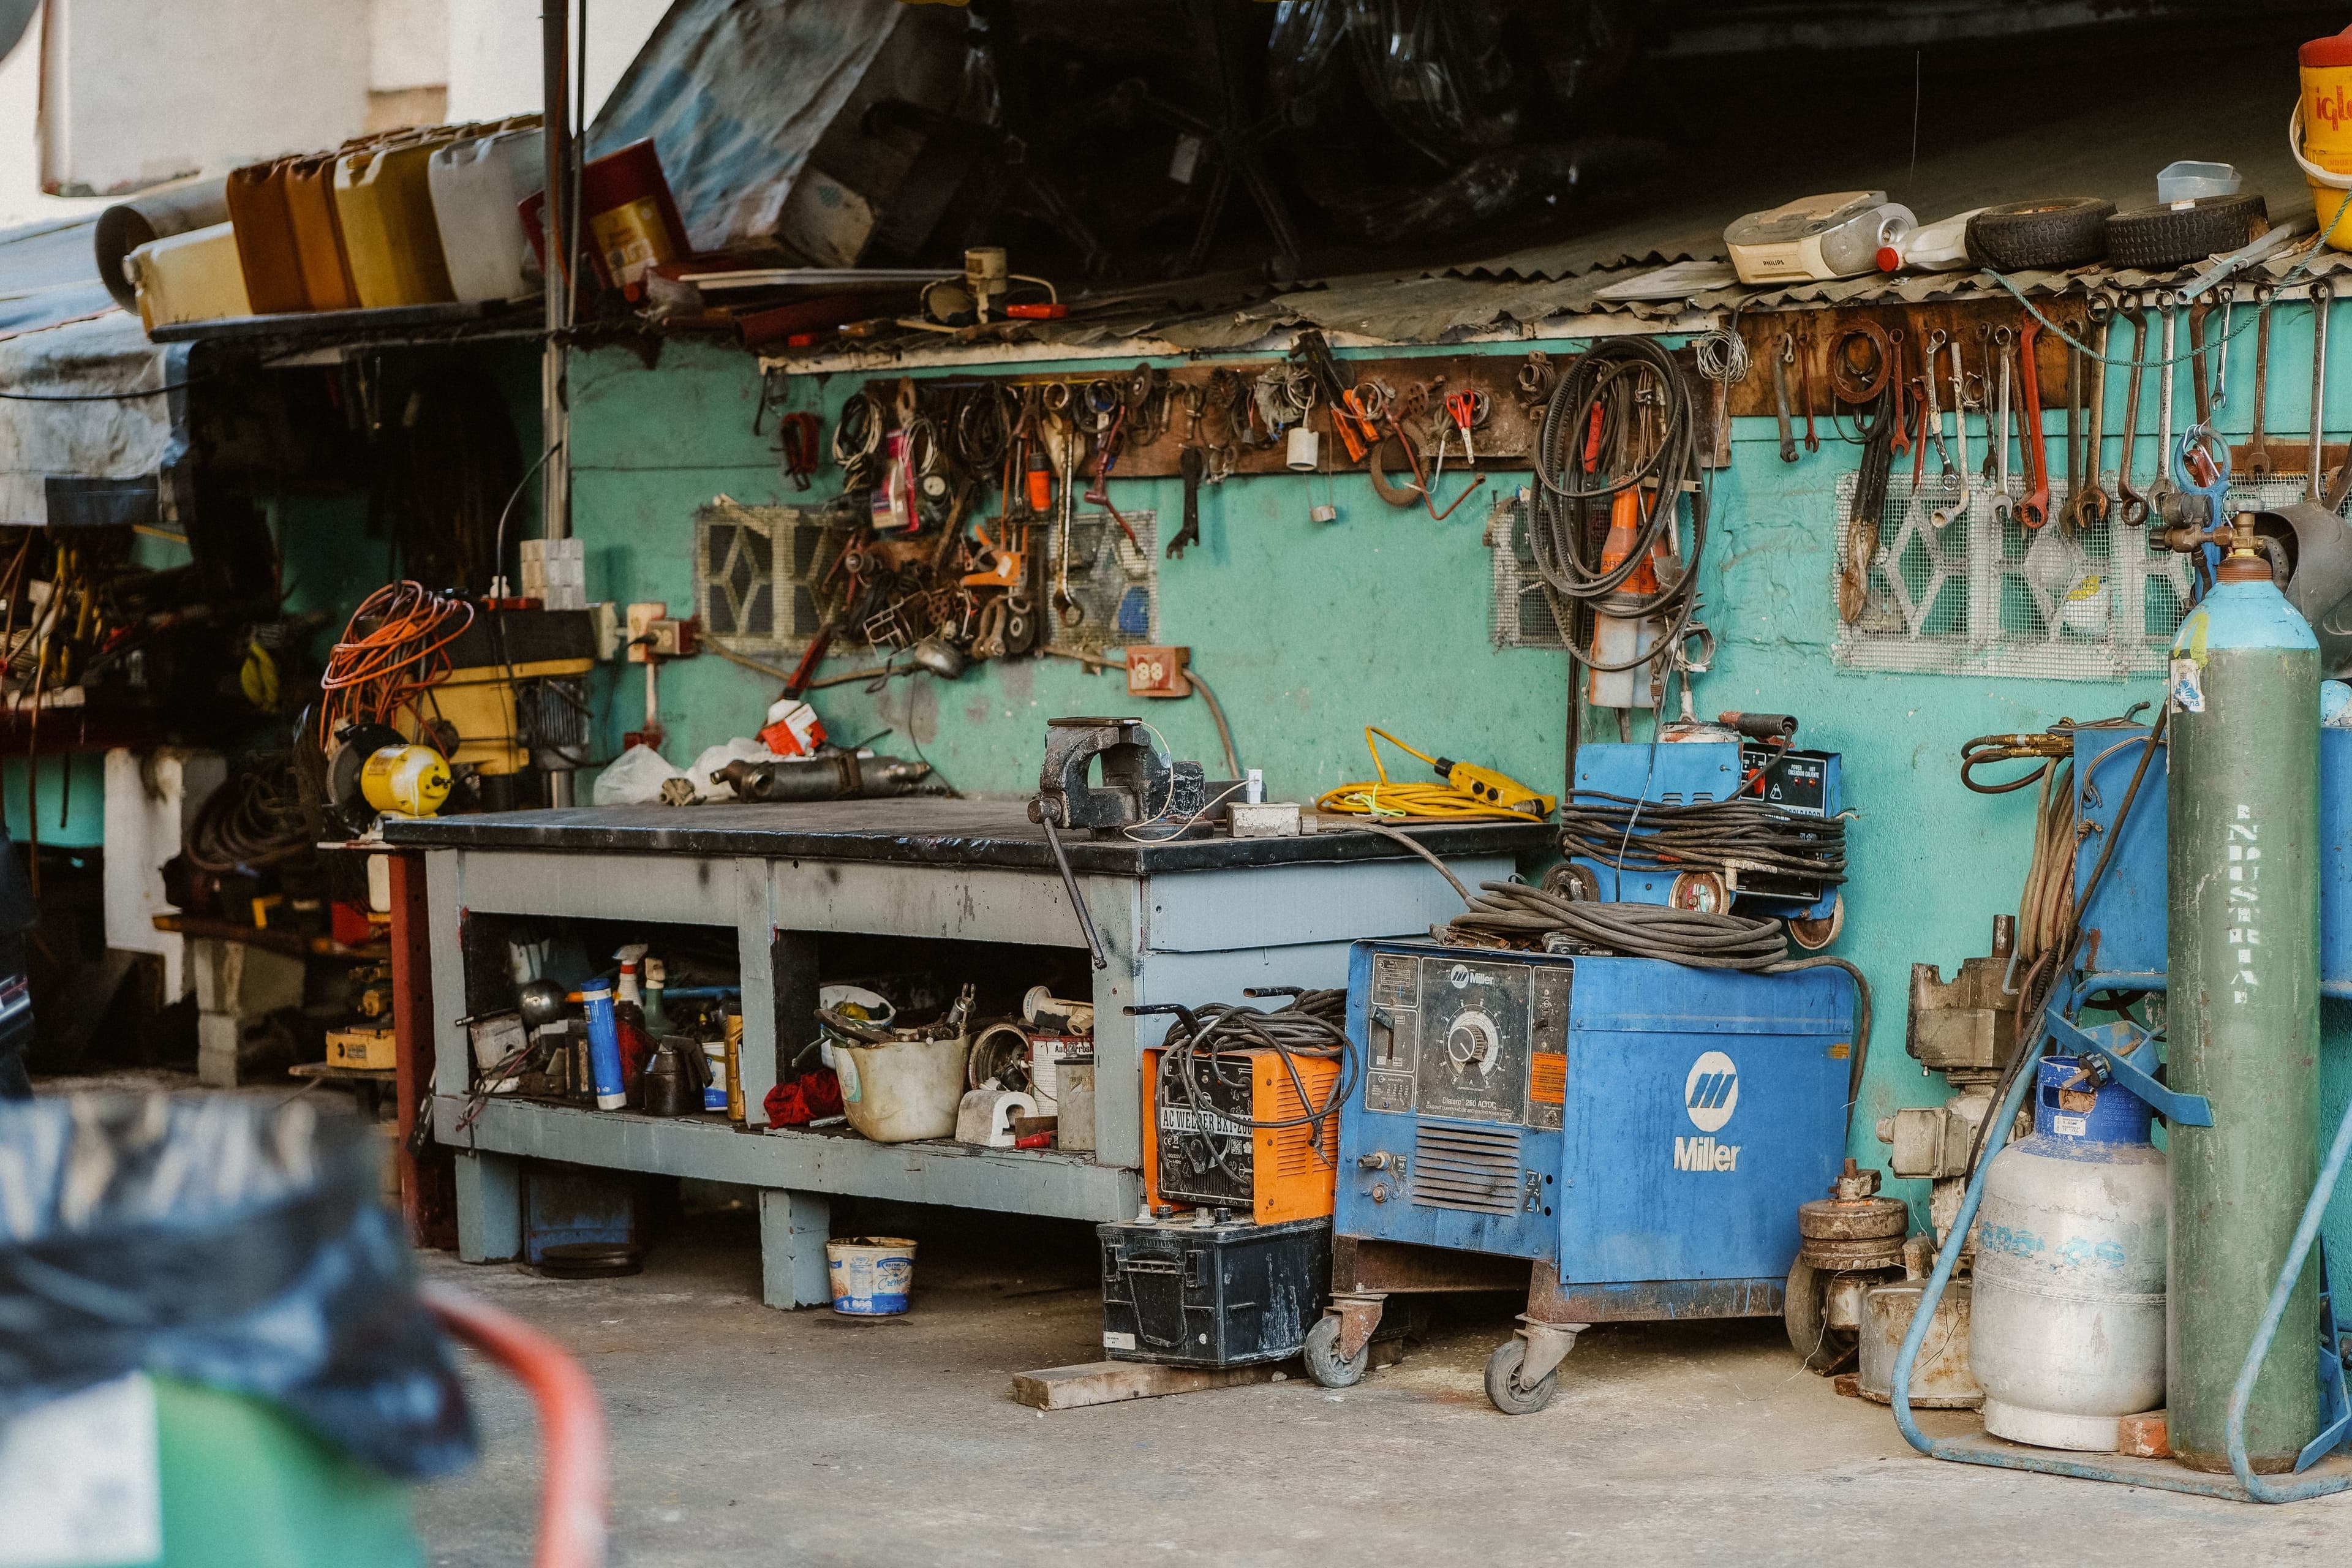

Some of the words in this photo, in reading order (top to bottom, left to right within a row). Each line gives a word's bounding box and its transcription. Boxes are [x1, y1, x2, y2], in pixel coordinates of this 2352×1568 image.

[1470, 972, 1494, 985] Miller
[1442, 1096, 1461, 1106] Dialarc
[1163, 1109, 1175, 1127] AC
[1673, 1136, 1741, 1172] Miller
